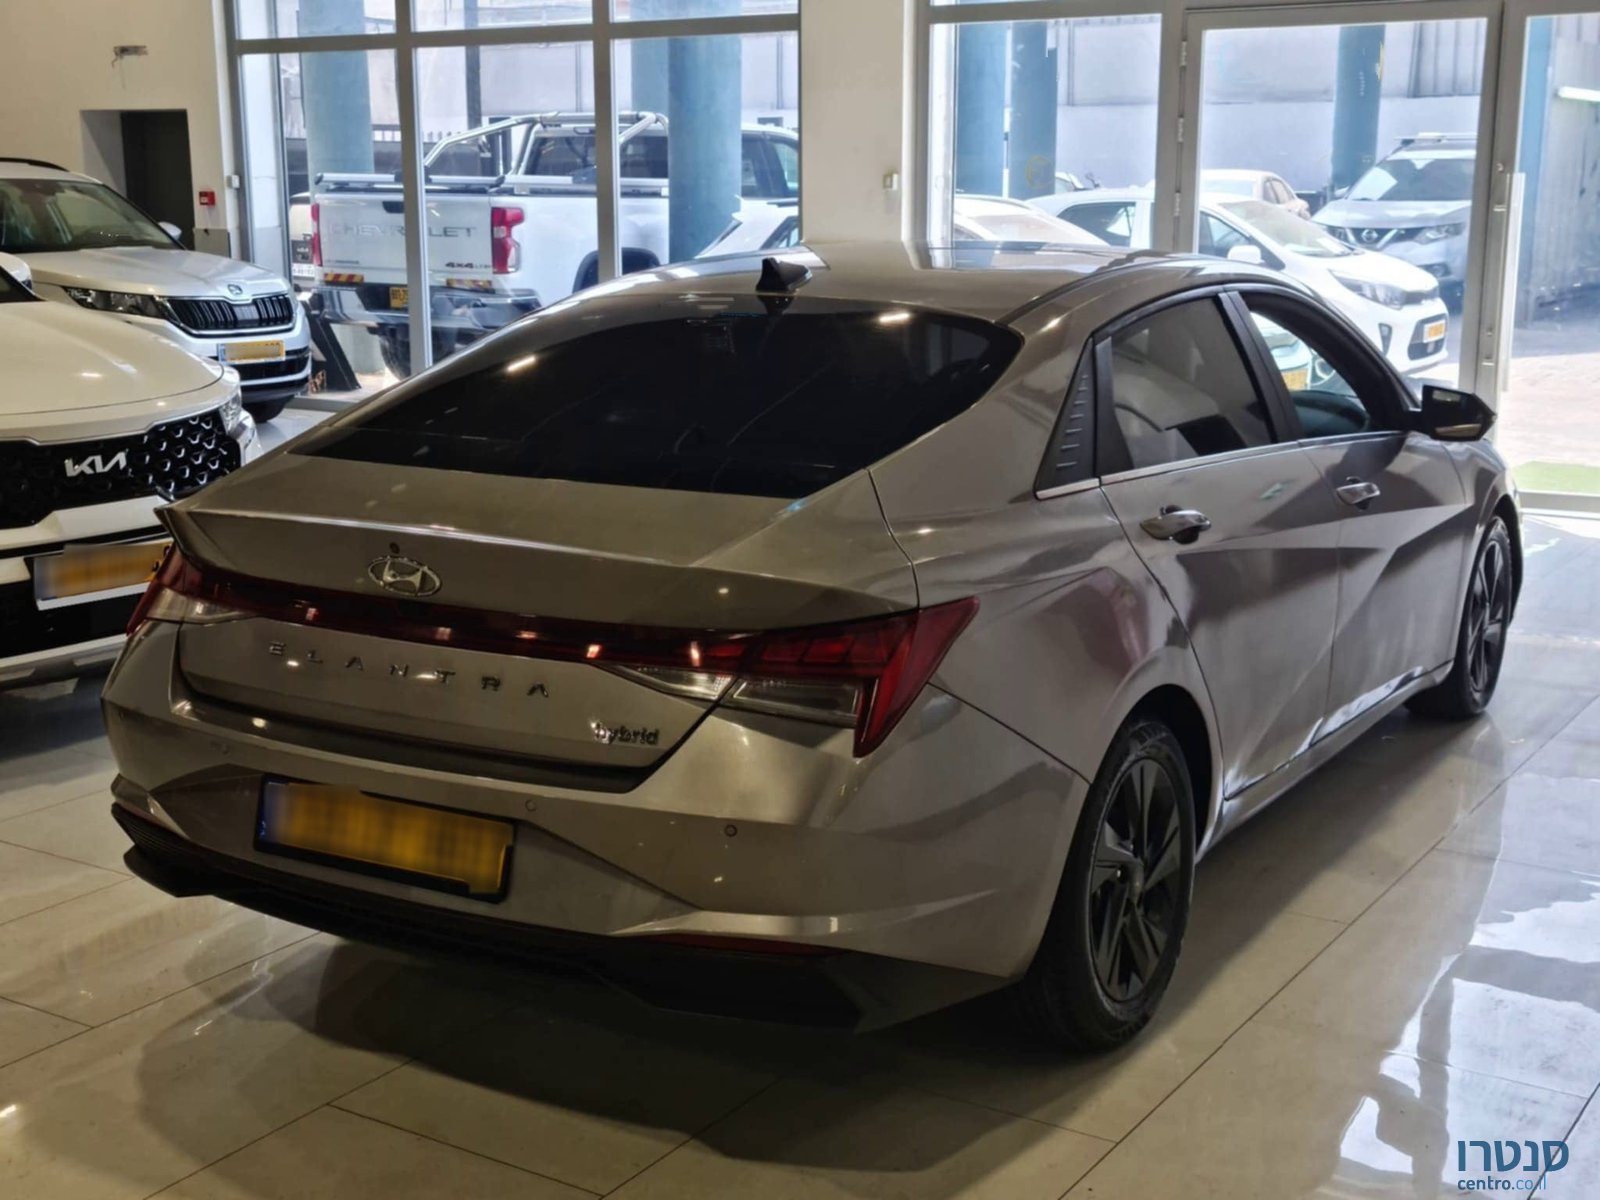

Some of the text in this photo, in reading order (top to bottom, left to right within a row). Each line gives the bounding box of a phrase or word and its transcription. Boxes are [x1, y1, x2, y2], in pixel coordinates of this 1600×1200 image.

[331, 223, 477, 238] CHEVRLET
[64, 450, 127, 477] KIA
[268, 641, 550, 698] ELANTRA
